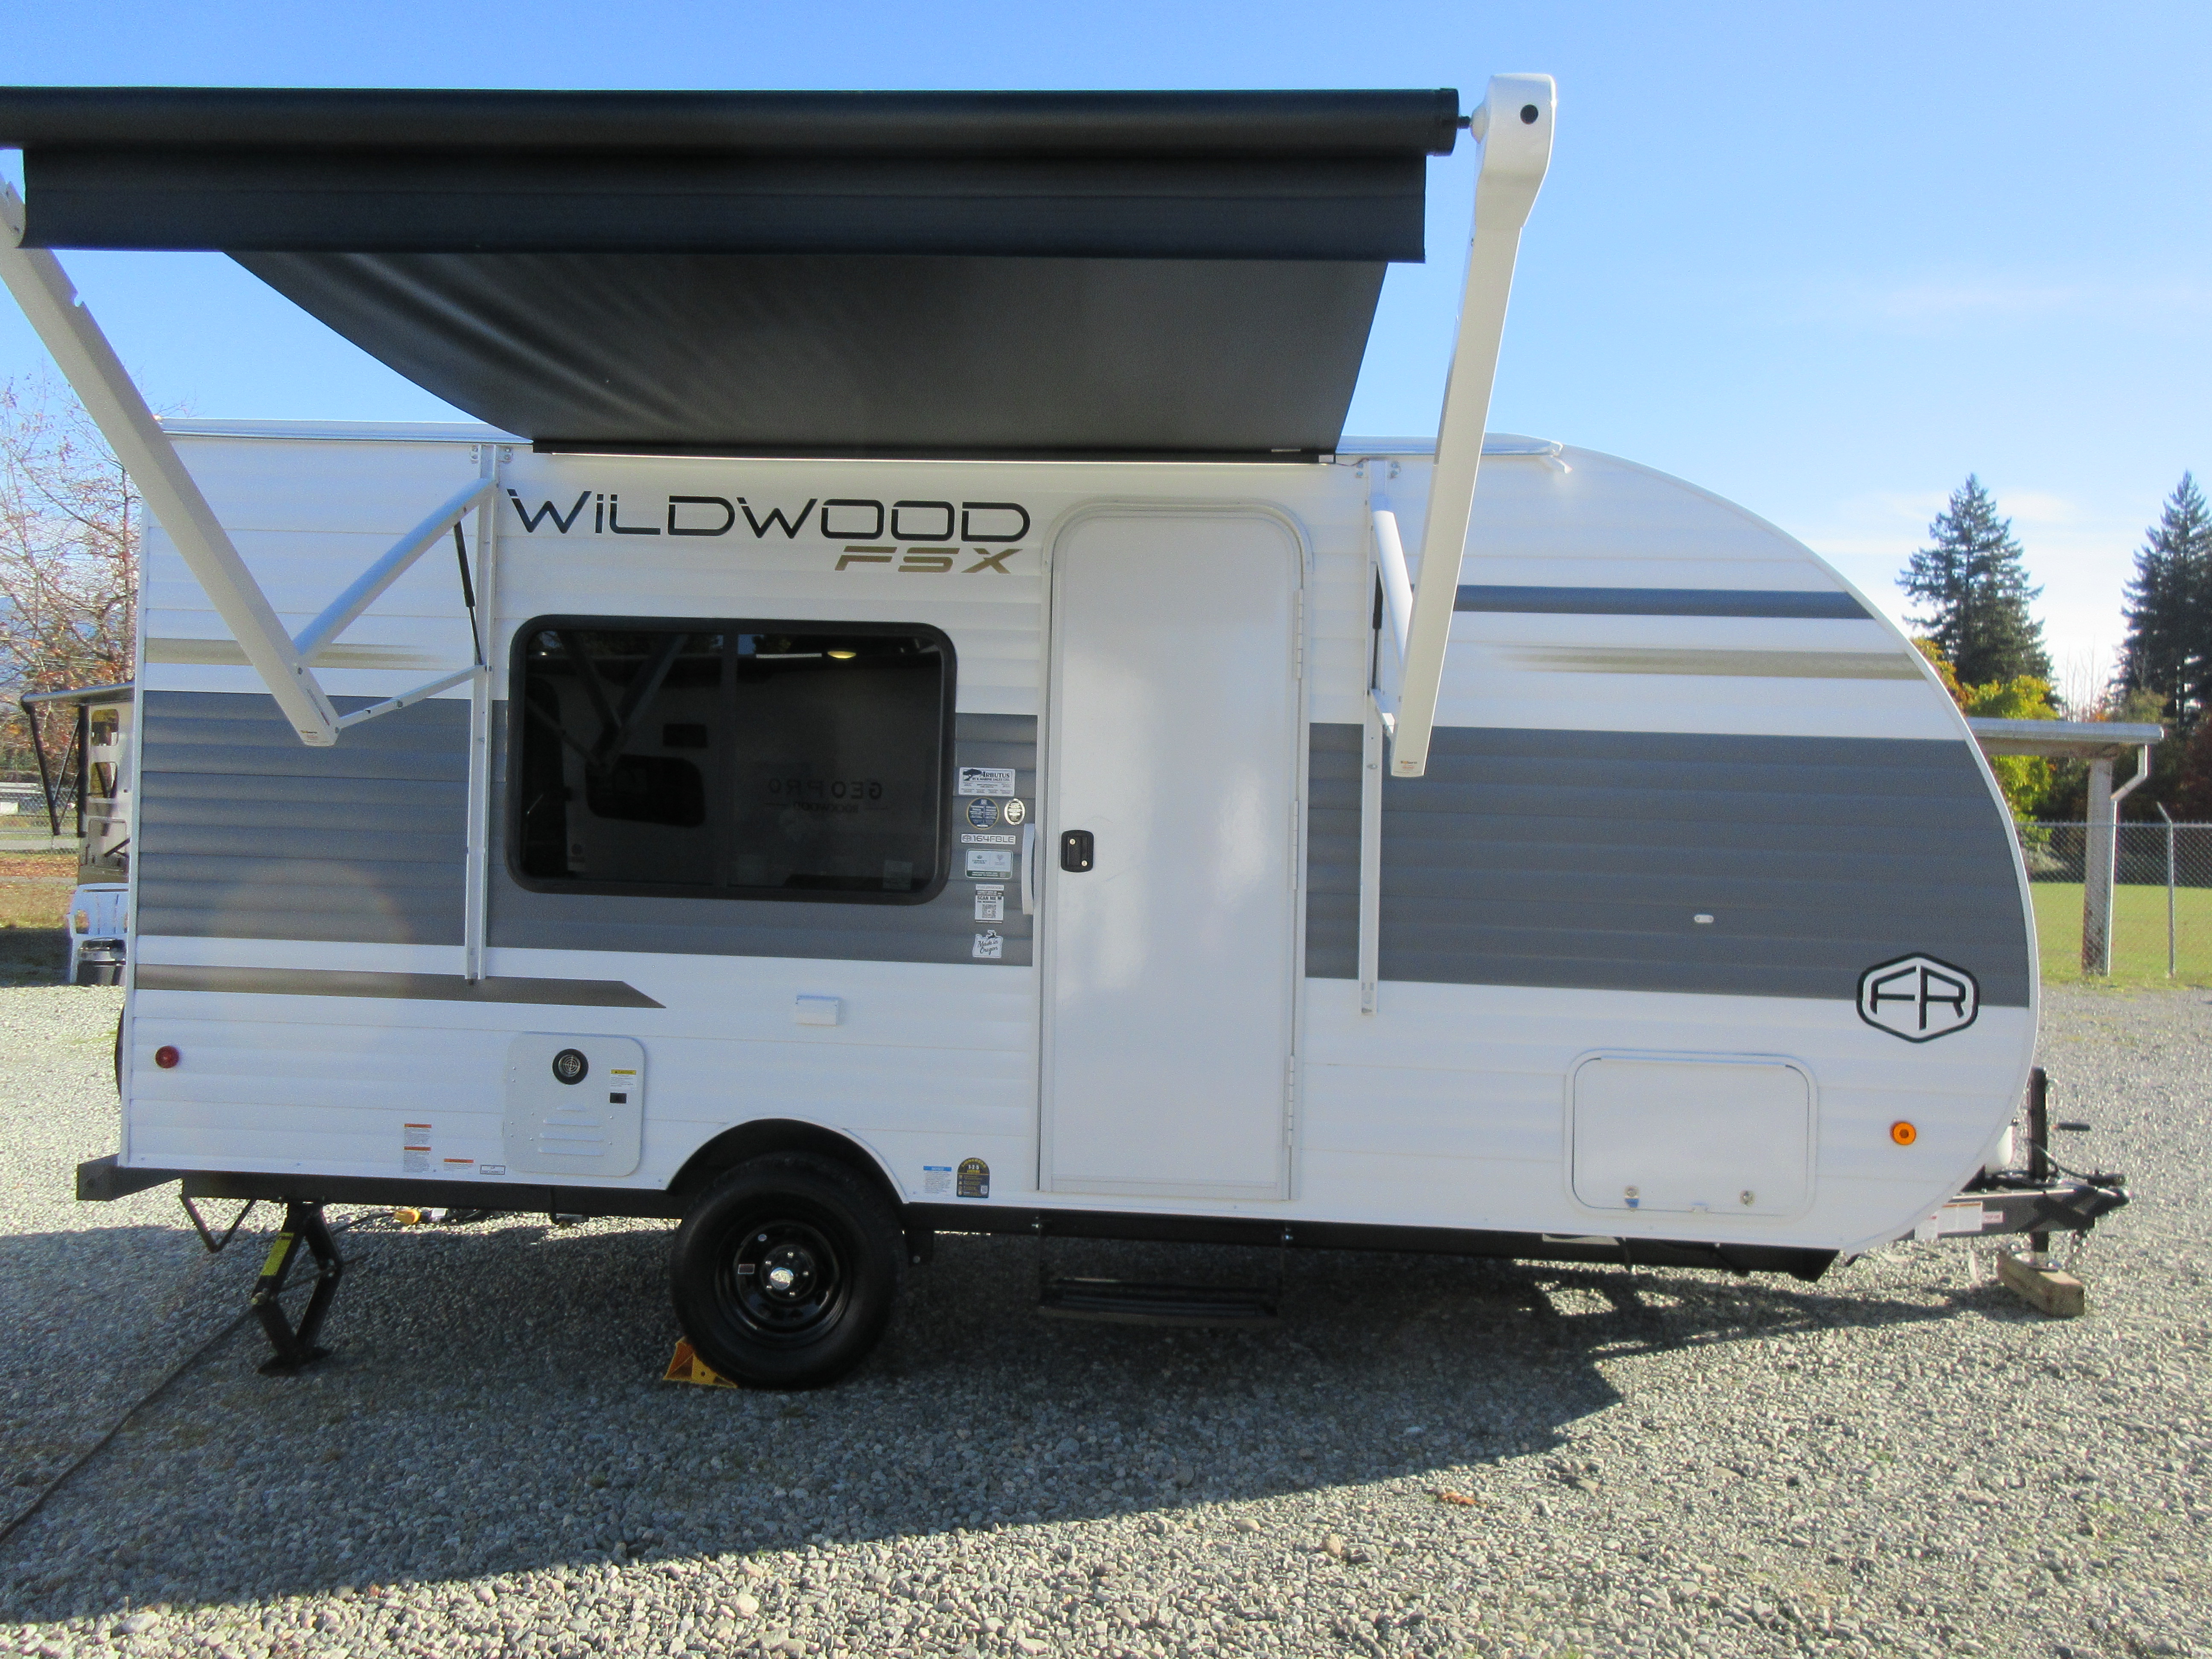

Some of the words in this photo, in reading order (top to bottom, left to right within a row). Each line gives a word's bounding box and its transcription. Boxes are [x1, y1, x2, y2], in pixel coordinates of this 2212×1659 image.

[506, 489, 1030, 542] WILDWOOD
[835, 546, 1023, 574] FSX
[973, 835, 1014, 843] 164FBLE
[980, 946, 998, 955] Oregon
